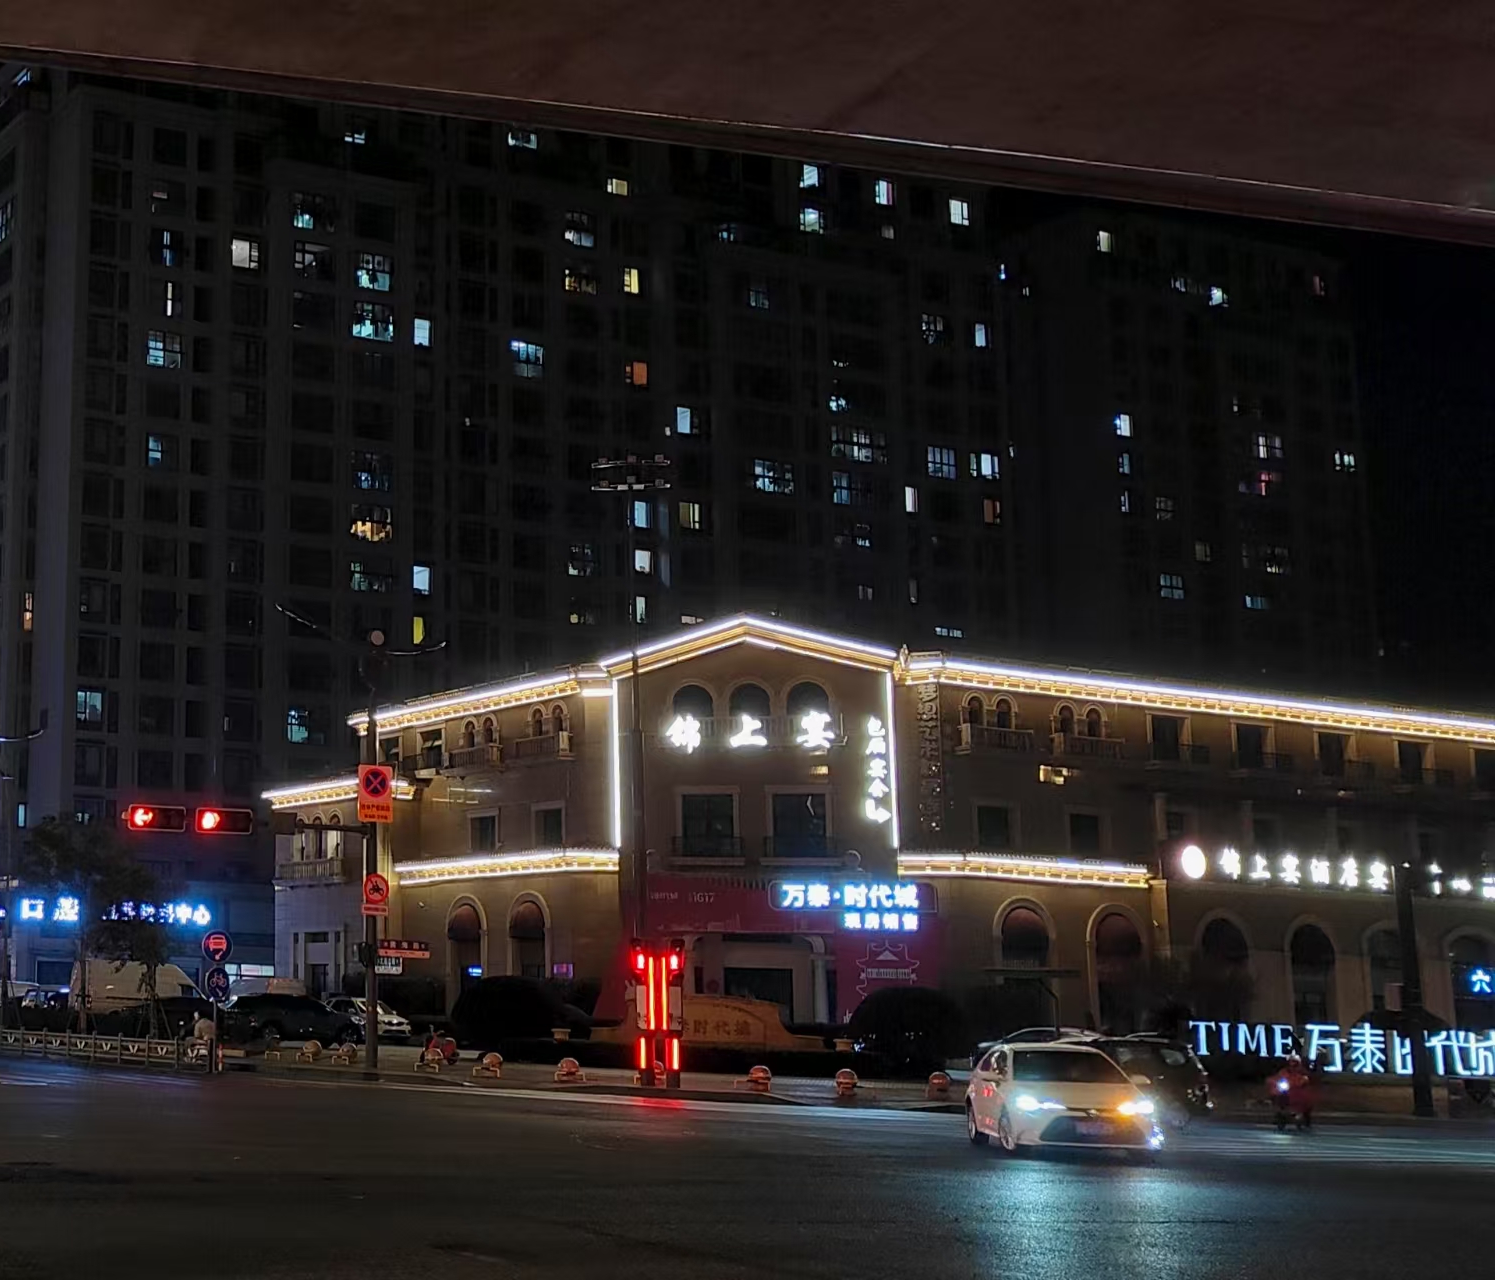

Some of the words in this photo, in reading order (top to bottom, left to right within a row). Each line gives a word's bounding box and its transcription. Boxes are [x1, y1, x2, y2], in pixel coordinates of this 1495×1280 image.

[666, 711, 834, 752] 锦上宴
[1189, 1020, 1294, 1058] TIME
